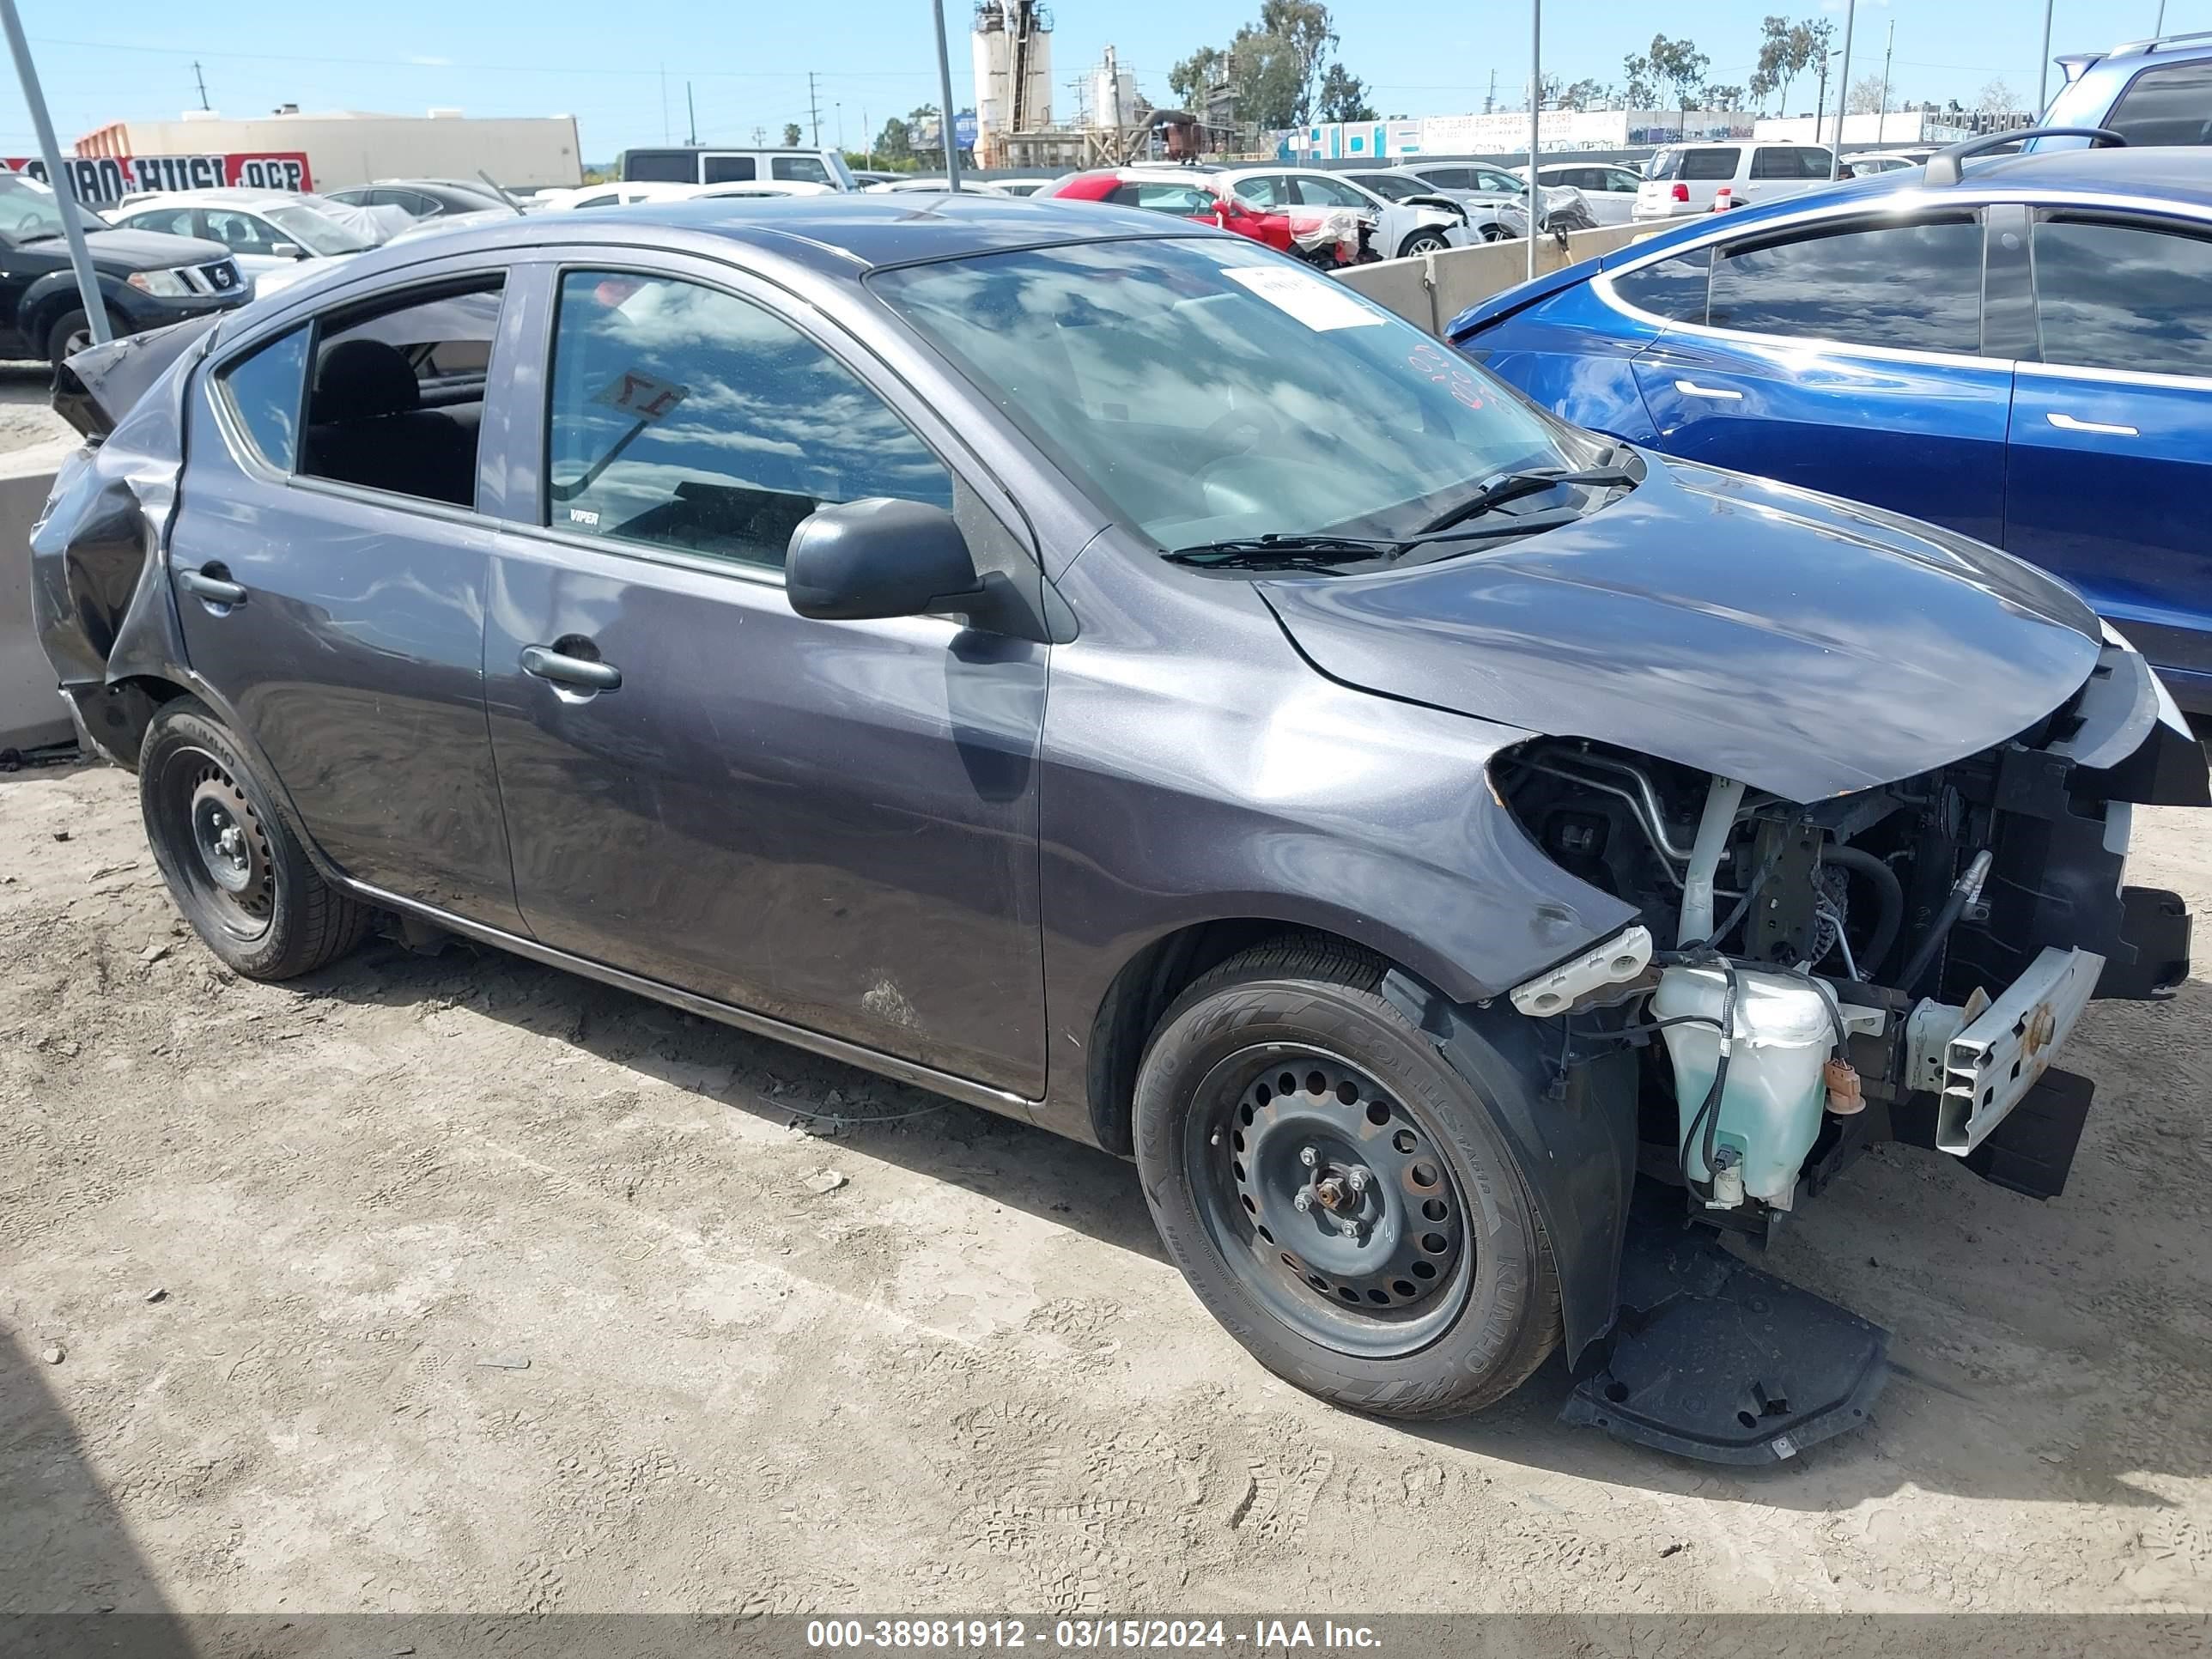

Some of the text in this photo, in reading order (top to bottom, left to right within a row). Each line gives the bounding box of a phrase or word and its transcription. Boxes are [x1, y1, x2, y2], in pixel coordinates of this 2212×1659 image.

[1528, 112, 1571, 124] RDIATORS
[570, 507, 599, 526] VIPER
[183, 720, 235, 768] KUMHO
[1142, 1049, 1179, 1161] KUMHO
[1462, 1254, 1519, 1376] KUMHO
